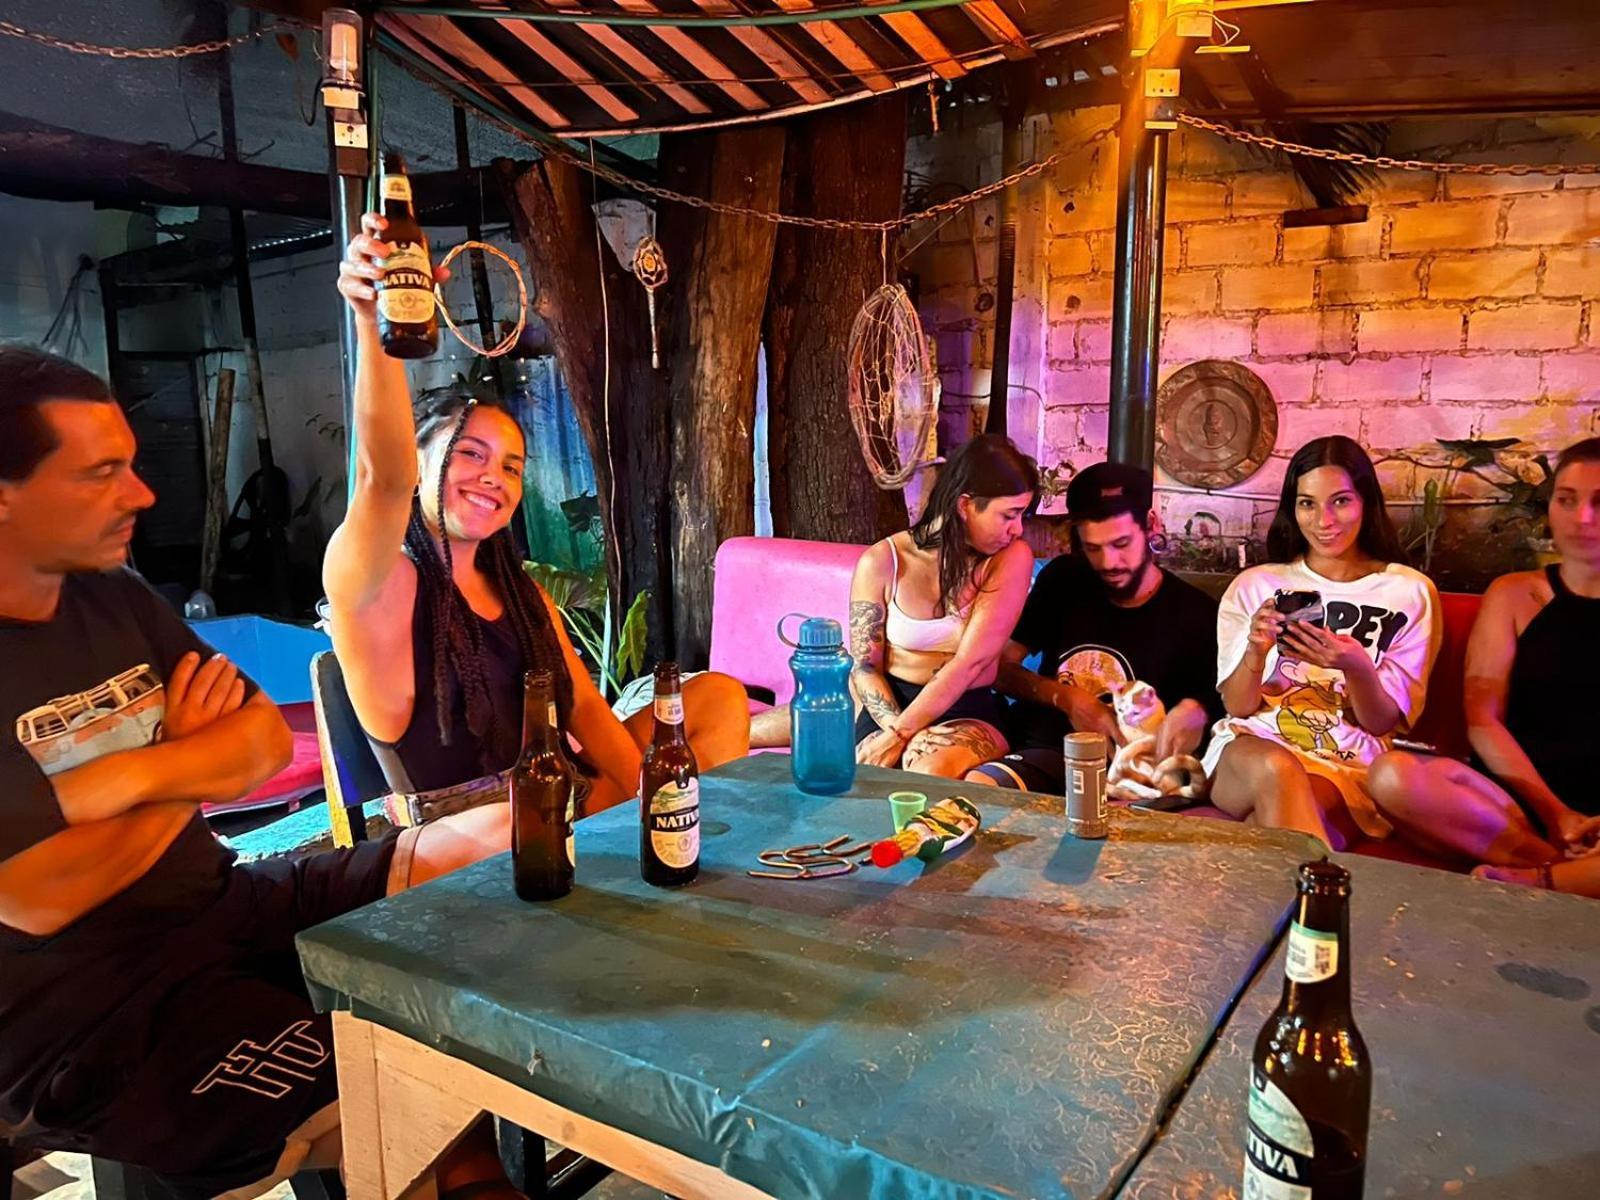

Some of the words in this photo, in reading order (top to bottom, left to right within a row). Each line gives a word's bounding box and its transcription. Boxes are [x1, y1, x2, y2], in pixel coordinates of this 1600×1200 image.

[1326, 601, 1408, 664] PEY
[656, 808, 699, 828] NATIV
[1247, 1126, 1299, 1179] TIVA
